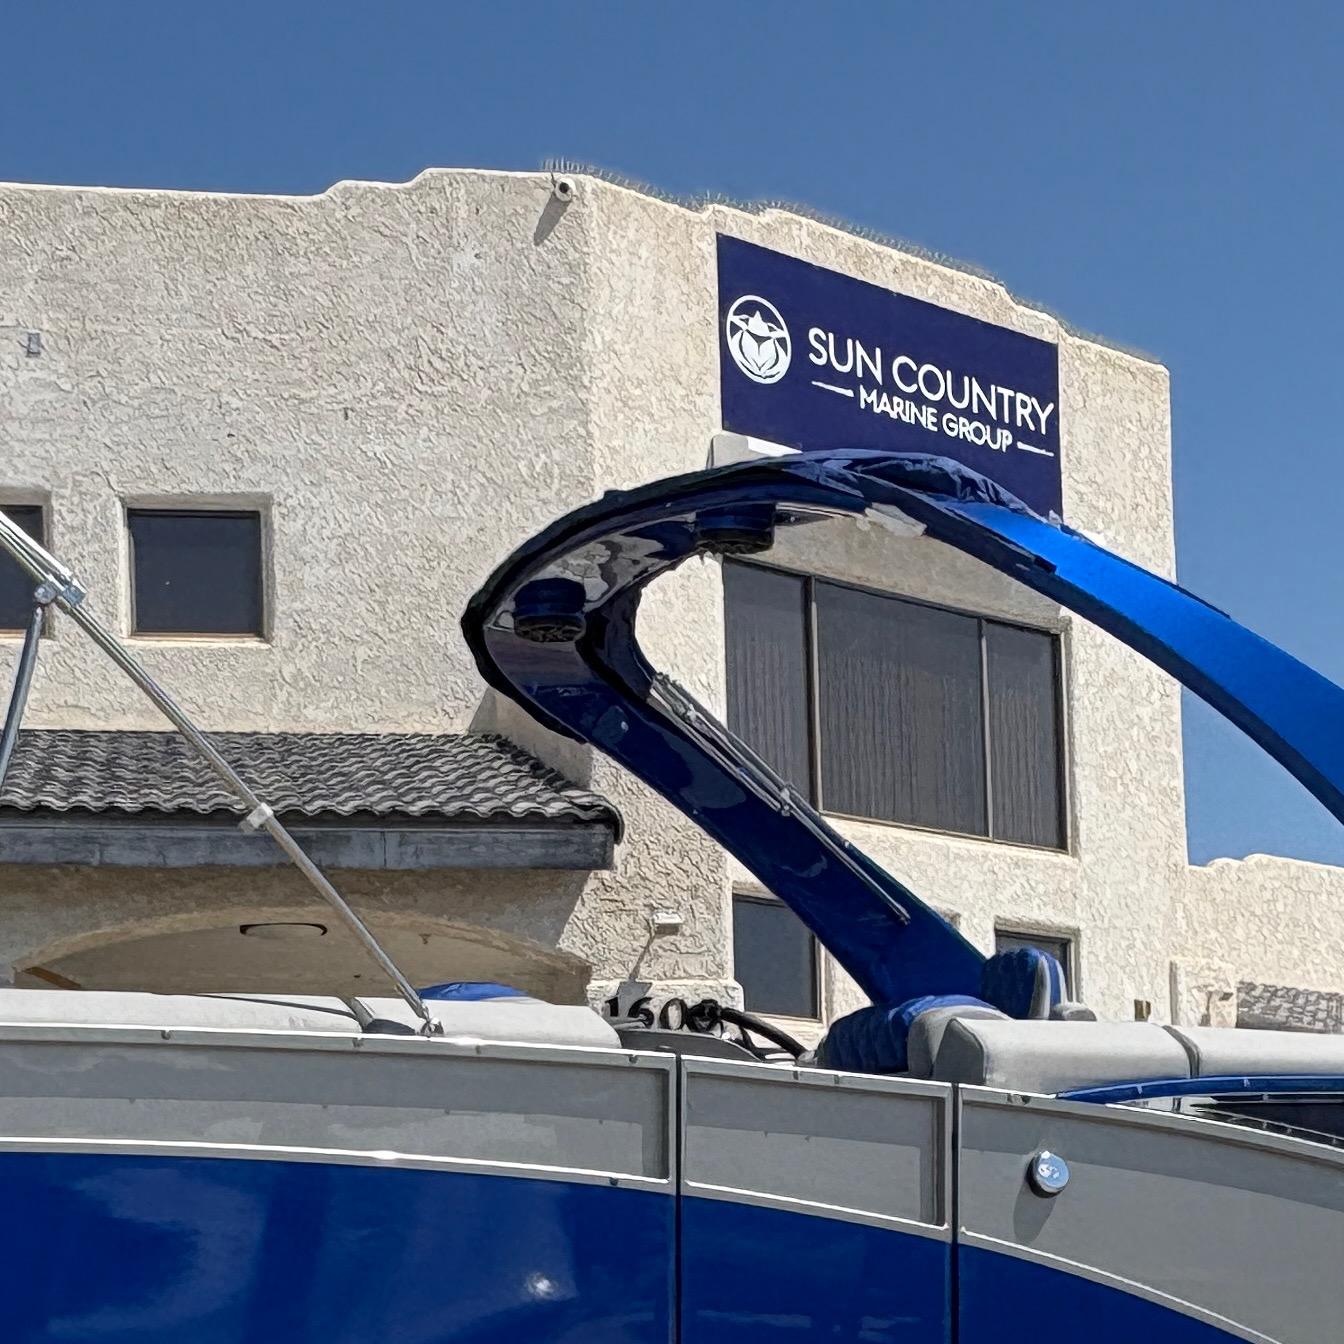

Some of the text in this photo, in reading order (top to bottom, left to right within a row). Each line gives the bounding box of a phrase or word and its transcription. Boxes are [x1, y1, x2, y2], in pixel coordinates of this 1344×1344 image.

[808, 326, 1055, 436] SUN COUNTRY
[859, 385, 1013, 452] MARINE GROUP
